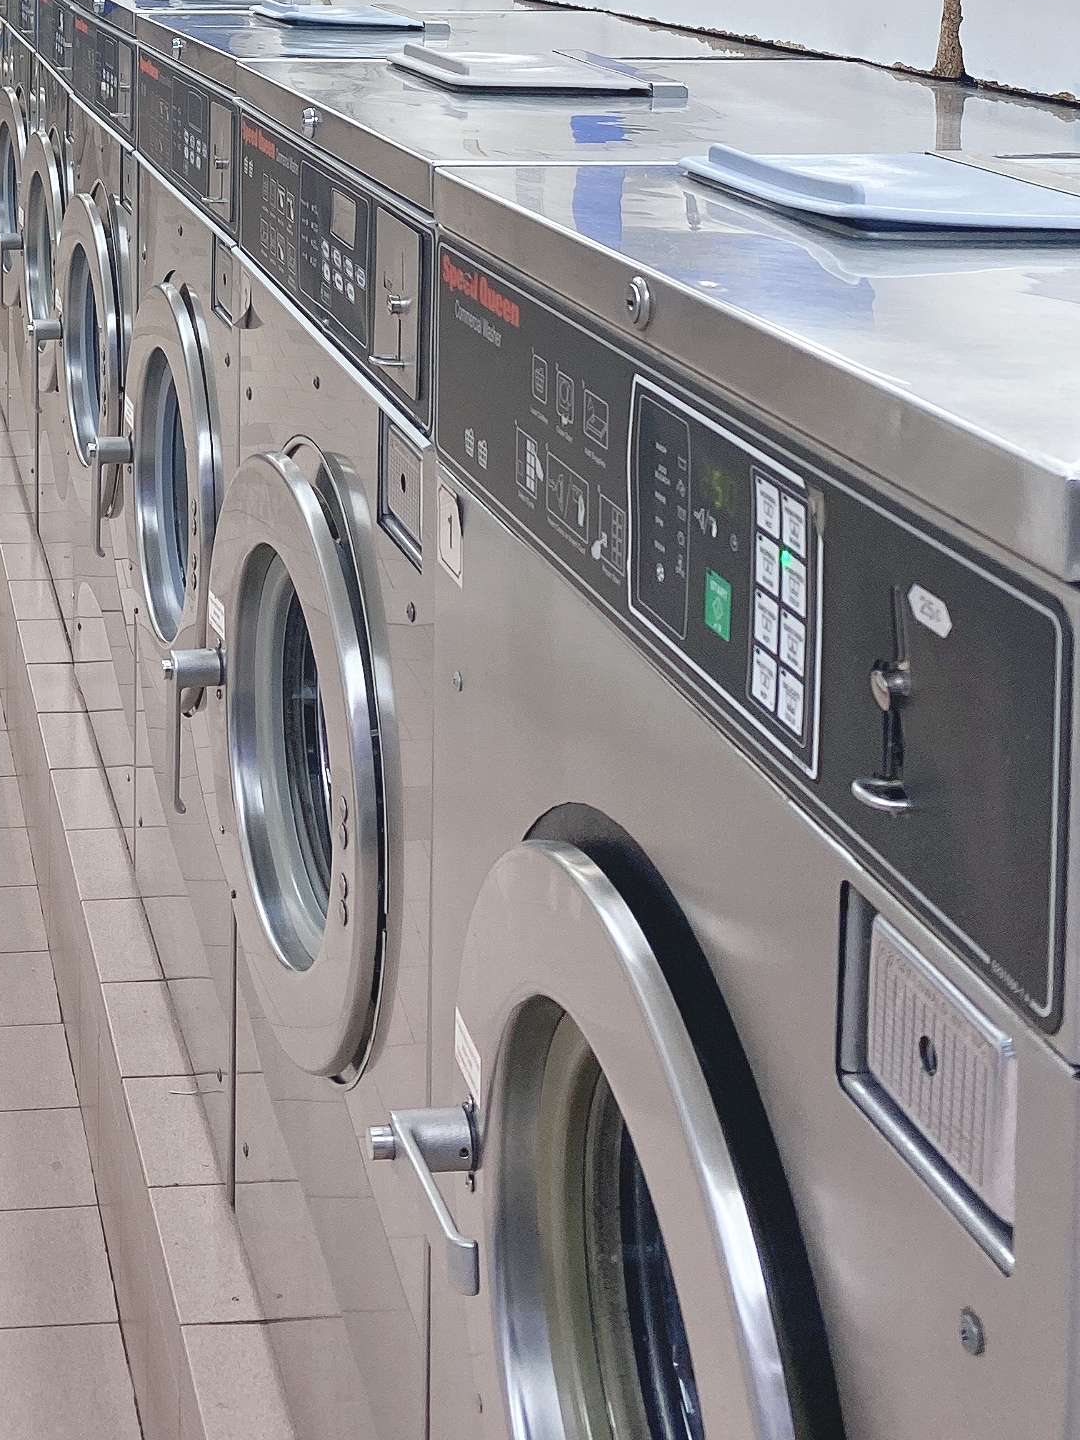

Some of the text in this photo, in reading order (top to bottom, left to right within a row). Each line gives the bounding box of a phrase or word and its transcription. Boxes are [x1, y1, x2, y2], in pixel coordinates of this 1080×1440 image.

[454, 300, 501, 348] Commercial Washer
[480, 276, 520, 328] Queen
